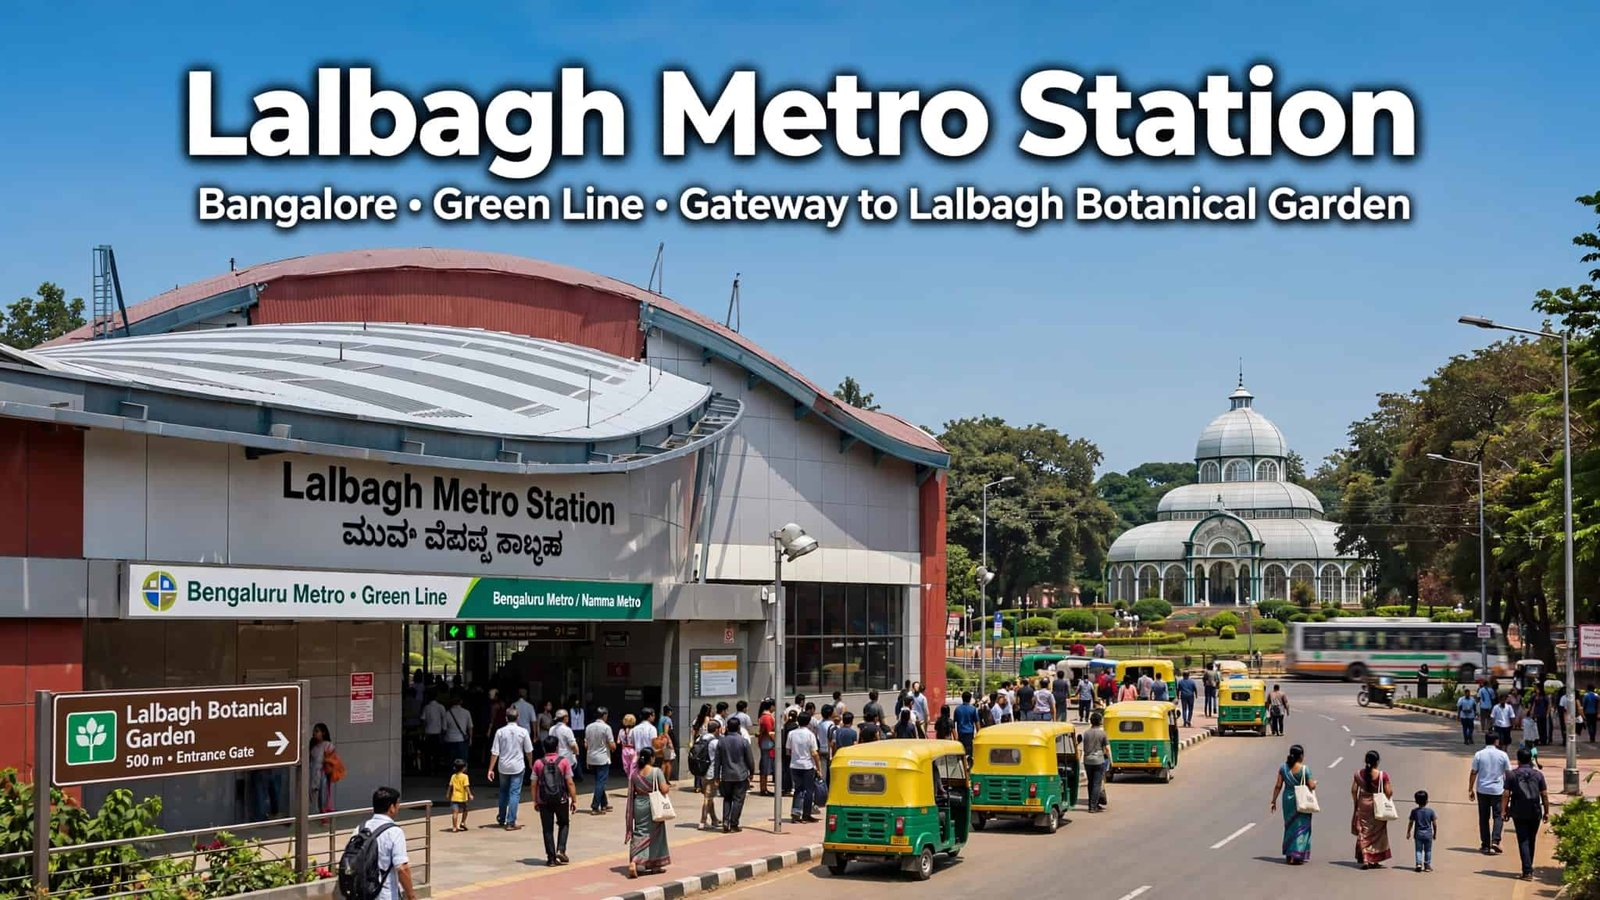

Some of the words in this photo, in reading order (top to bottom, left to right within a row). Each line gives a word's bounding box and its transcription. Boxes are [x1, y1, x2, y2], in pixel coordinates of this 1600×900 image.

[283, 461, 423, 515] Lalbagh
[433, 475, 519, 517] Metro
[526, 486, 615, 525] Station
[187, 580, 288, 607] Bengaluru
[293, 583, 345, 604] Metro
[362, 585, 410, 606] Green
[415, 586, 448, 606] Line
[493, 591, 544, 609] Bengaluru
[546, 593, 574, 607] Metro
[581, 593, 615, 608] Namma
[616, 595, 641, 609] Metro
[126, 700, 202, 727] Lalbagh
[207, 696, 288, 720] Botanical
[125, 725, 196, 749] Garden
[125, 753, 150, 768] 500
[152, 756, 164, 767] m
[176, 749, 226, 764] Entrance
[229, 746, 255, 760] Gate
